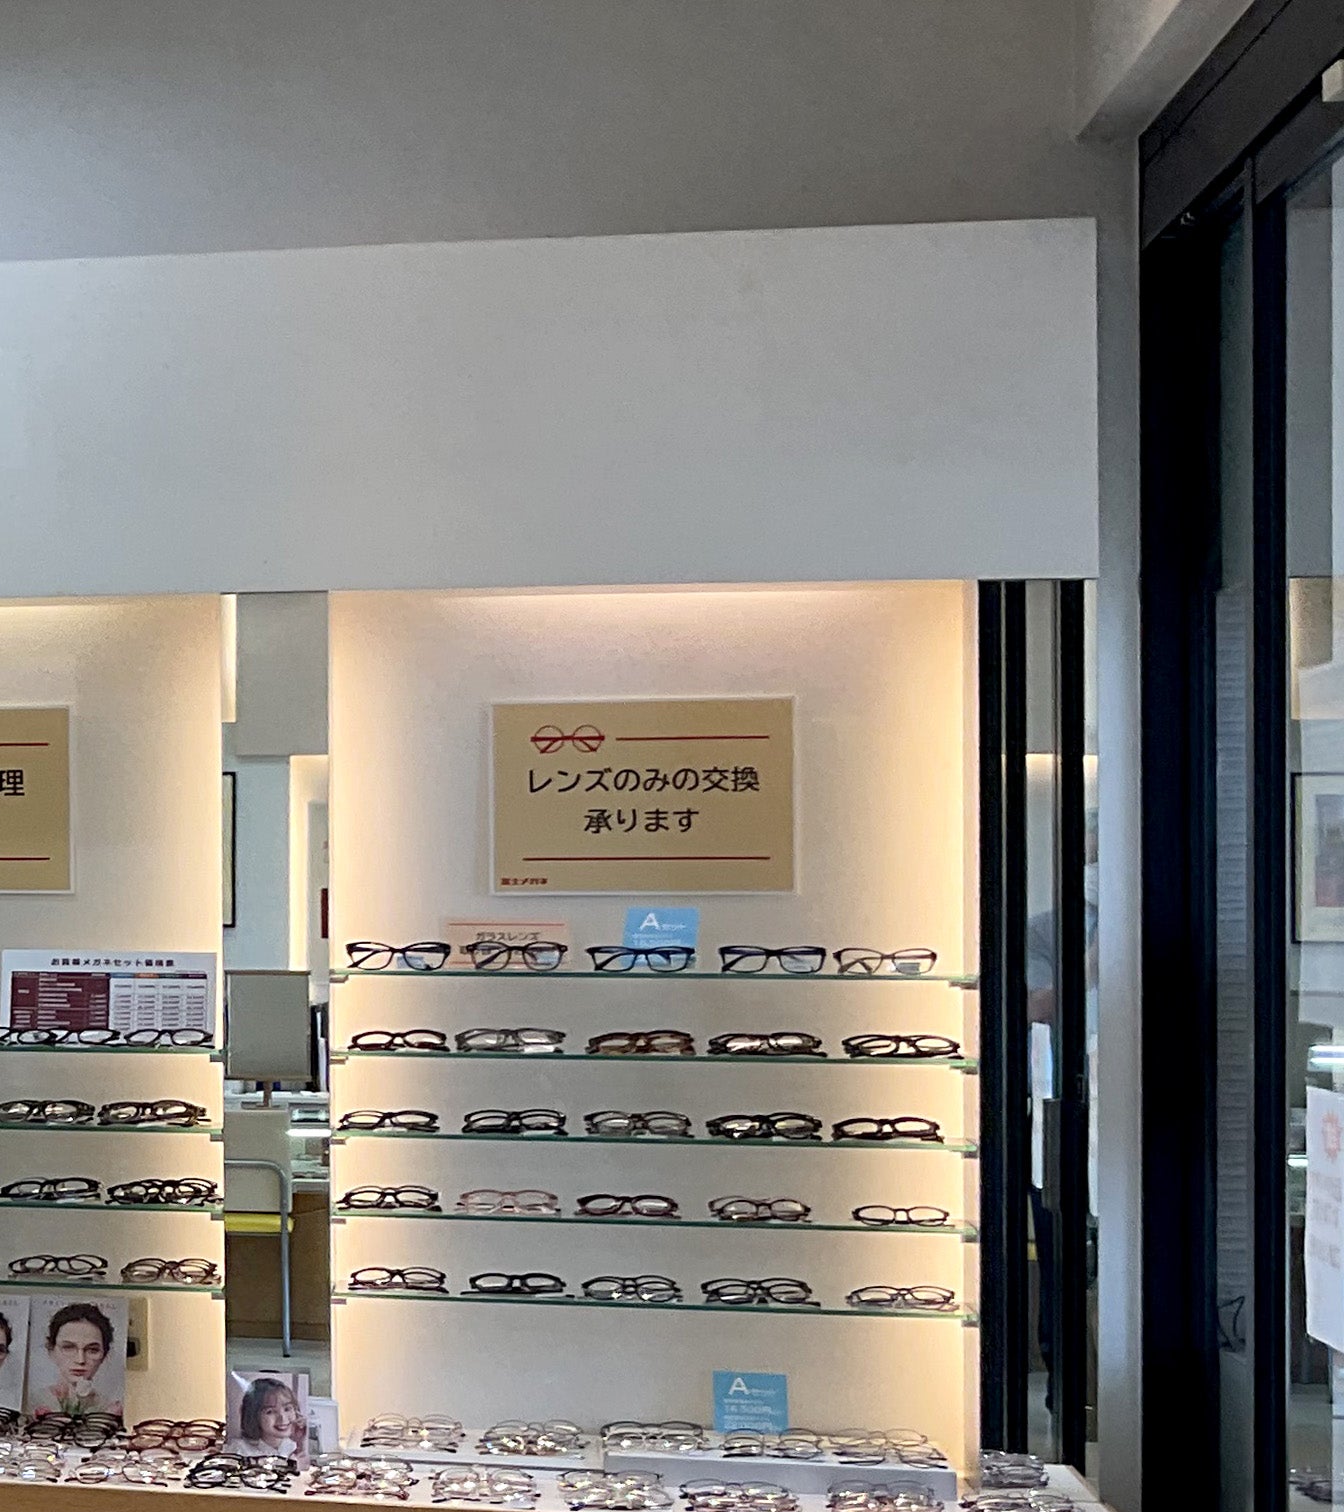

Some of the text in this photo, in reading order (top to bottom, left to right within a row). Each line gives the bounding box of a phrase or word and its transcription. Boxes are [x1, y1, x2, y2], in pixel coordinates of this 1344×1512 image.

[527, 765, 761, 795] レンズのみの交換
[583, 807, 700, 835] 承ります
